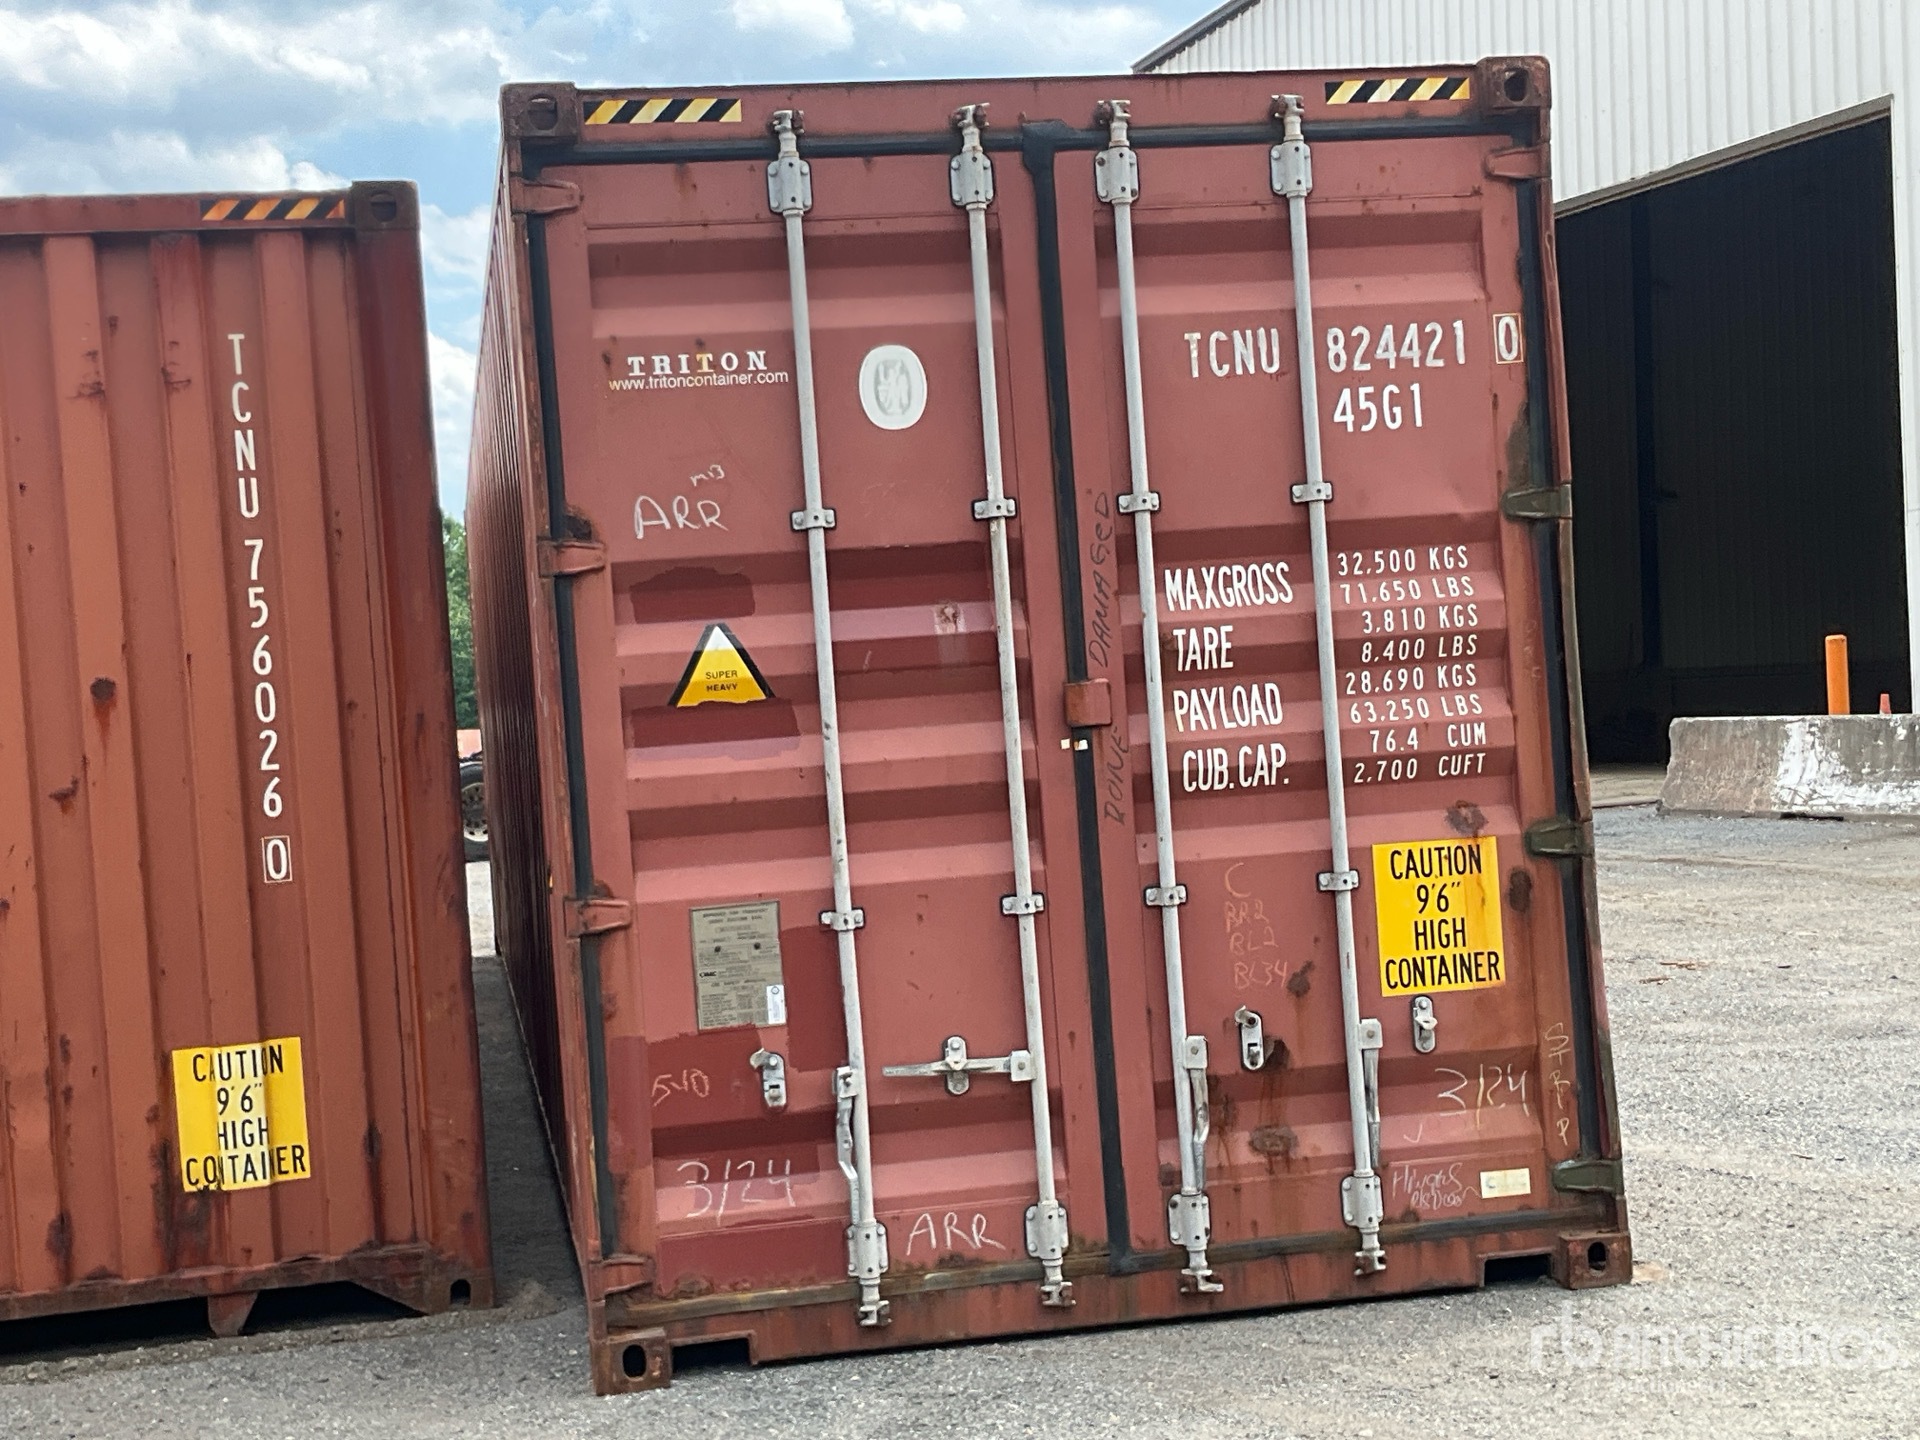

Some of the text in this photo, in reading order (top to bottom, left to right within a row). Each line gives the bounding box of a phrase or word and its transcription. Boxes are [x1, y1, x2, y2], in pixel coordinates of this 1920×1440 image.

[1183, 314, 1521, 378] TCNU 824421 0
[627, 350, 768, 377] TRITON
[608, 371, 789, 391] www.tritoncontainer.com
[1333, 382, 1424, 432] 45G1
[1428, 545, 1470, 572] KGS
[1164, 561, 1295, 612] MAXGROSS
[1432, 575, 1475, 599] LBS
[227, 333, 290, 881] TCNU 756026 0
[1437, 603, 1479, 628] KGS
[1172, 625, 1236, 673] TARE
[1437, 633, 1478, 659] LBS
[705, 669, 738, 680] SUPER
[705, 682, 738, 692] HEAVY
[1436, 663, 1477, 689] KGS
[1173, 682, 1284, 733] PAYLOAD
[1440, 693, 1483, 717] LBS
[1369, 722, 1487, 753] 76.4 CUM
[1437, 752, 1487, 776] CUFT
[1389, 843, 1483, 880] CAUTION
[1413, 917, 1467, 951] HIGH
[1384, 950, 1501, 990] CONTAINER
[217, 1117, 270, 1151] HIGH
[676, 1158, 797, 1227] 3/24
[905, 1211, 1007, 1257] ARR
